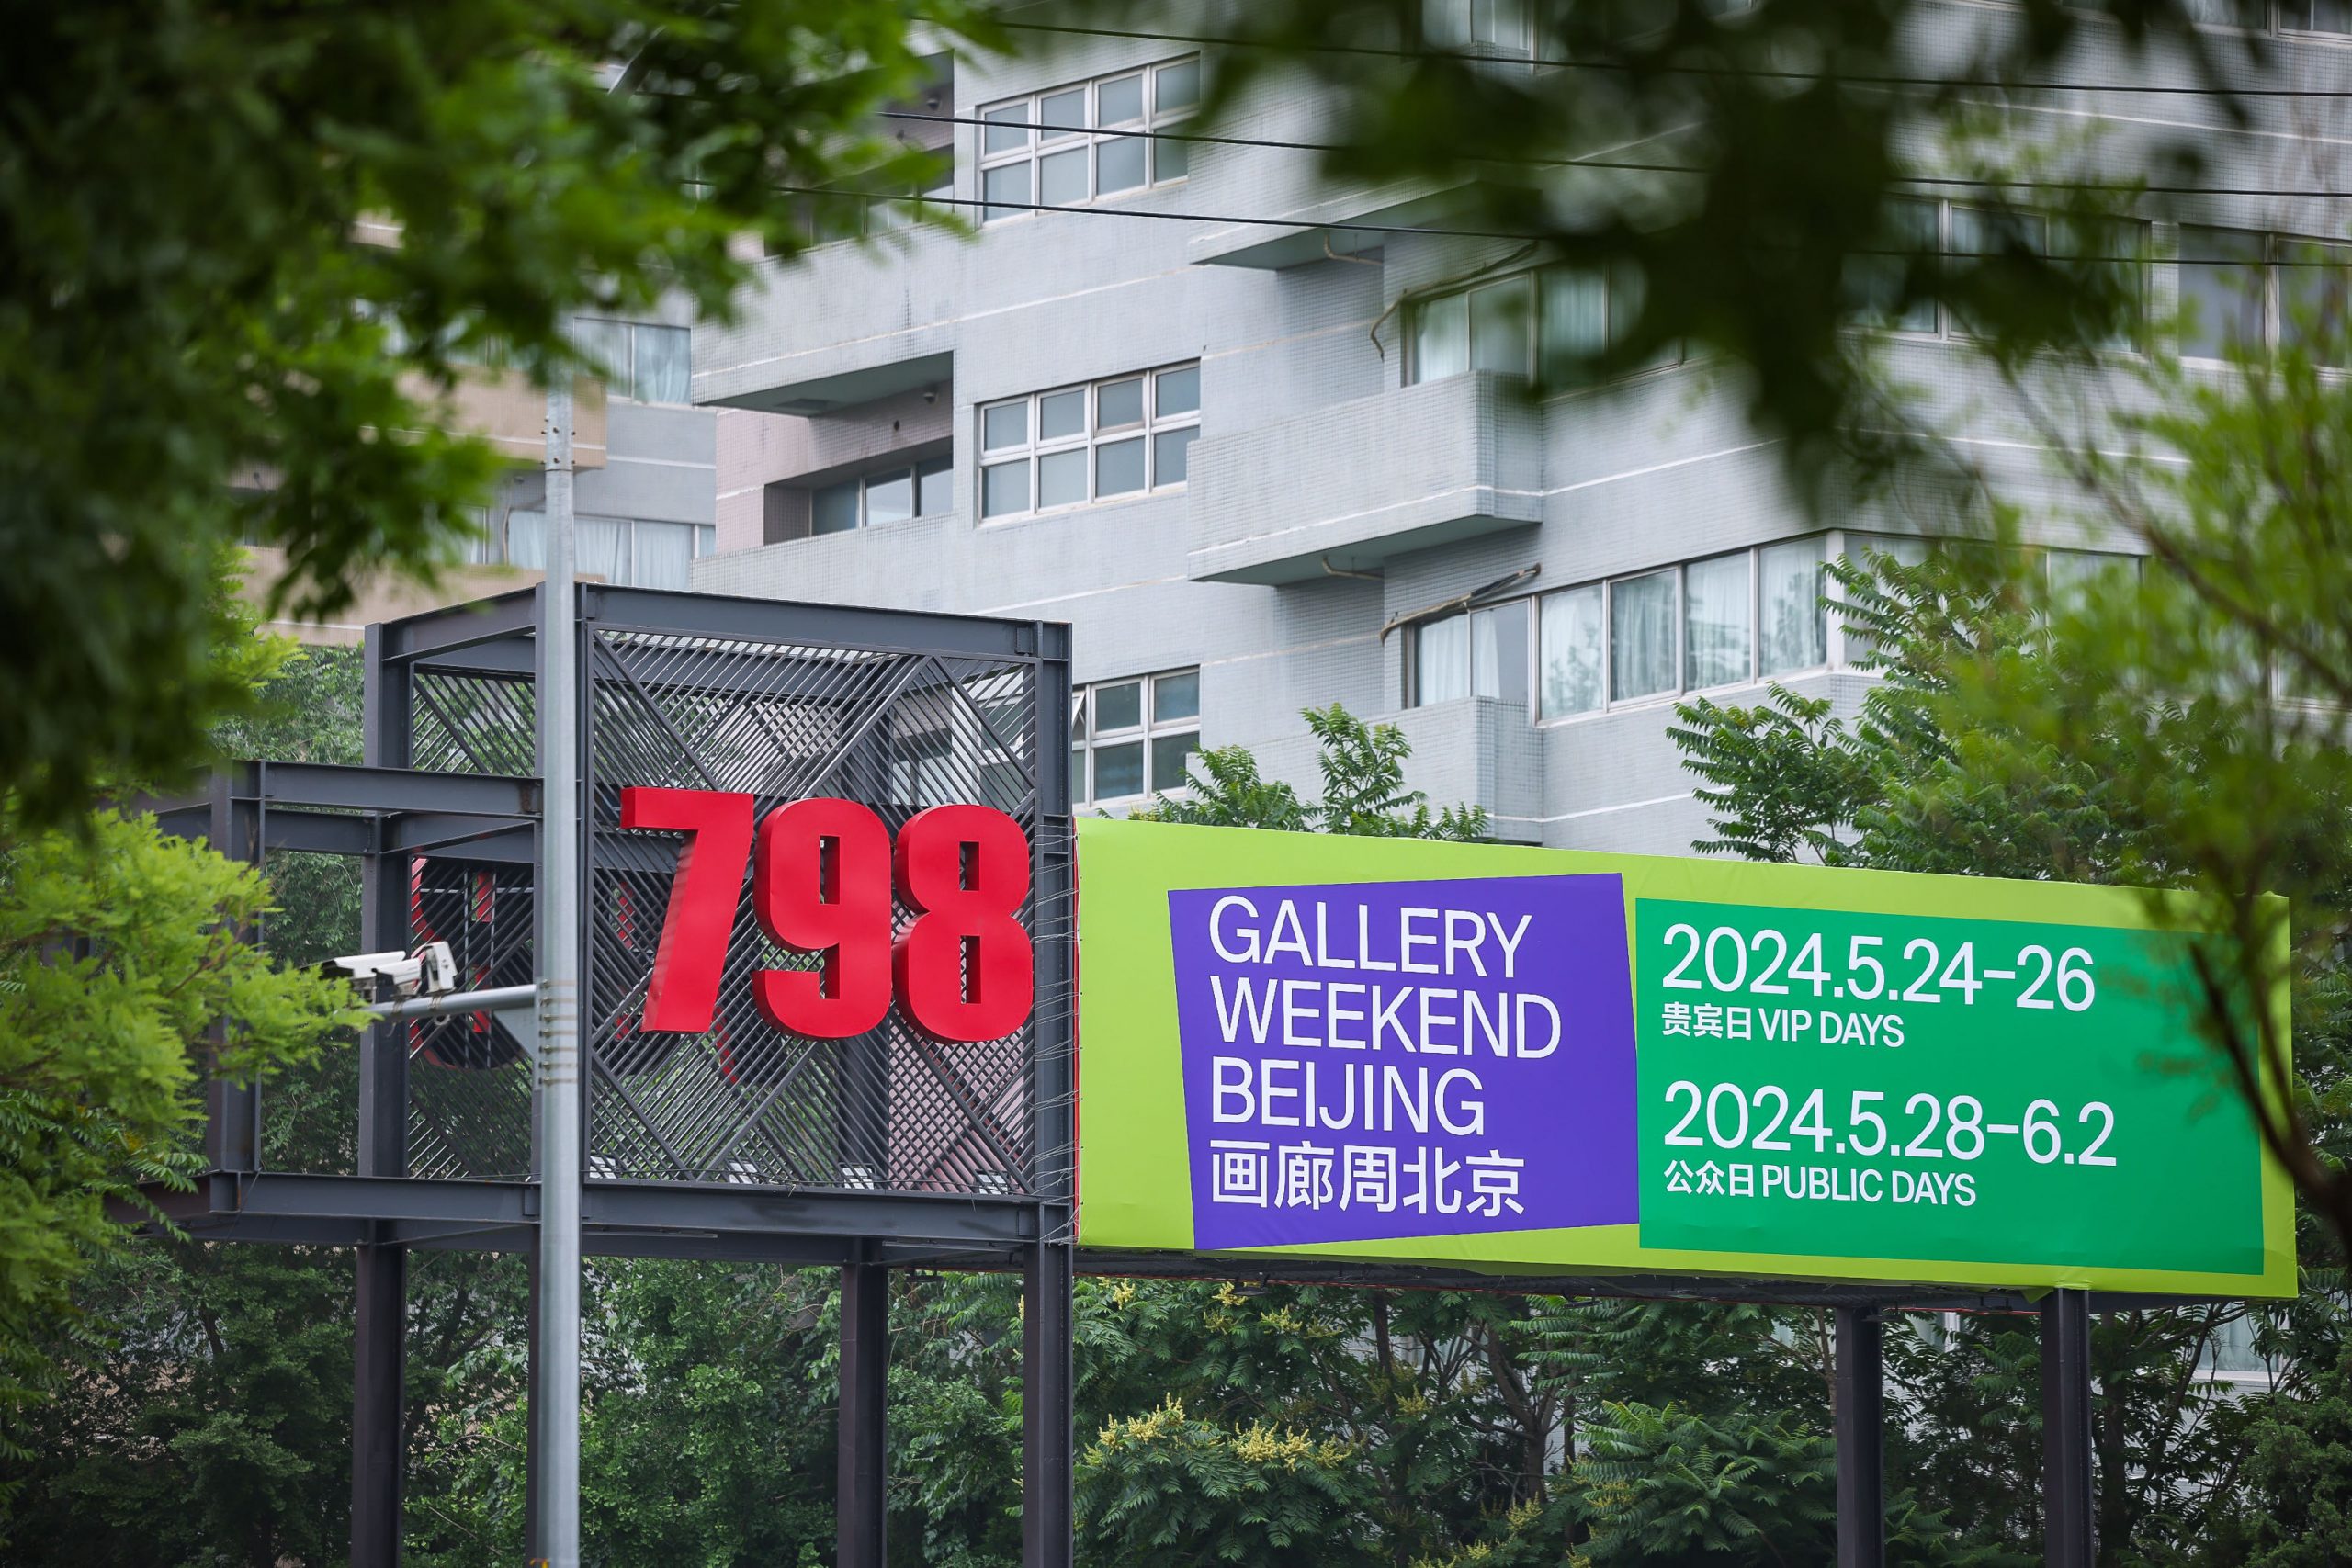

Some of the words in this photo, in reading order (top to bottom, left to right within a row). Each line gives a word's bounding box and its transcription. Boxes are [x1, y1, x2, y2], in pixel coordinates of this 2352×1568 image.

[620, 785, 1035, 1043] 798
[1209, 895, 1532, 978] GALLERY
[1662, 923, 2095, 1011] 2024.5.24-26
[1209, 975, 1561, 1059] WEEKEND
[1661, 1001, 1752, 1041] 贵宾日
[1758, 1008, 1812, 1042] VIP
[1820, 1010, 1905, 1047] DAYS
[1212, 1055, 1484, 1136] BEIJING
[1664, 1080, 2117, 1167] 2024.5.28-6.2
[1210, 1139, 1525, 1217] 画廊周北京
[1664, 1160, 1754, 1197] 公众日
[1762, 1164, 1883, 1202] PUBLIC
[1892, 1170, 1976, 1206] DAYS
